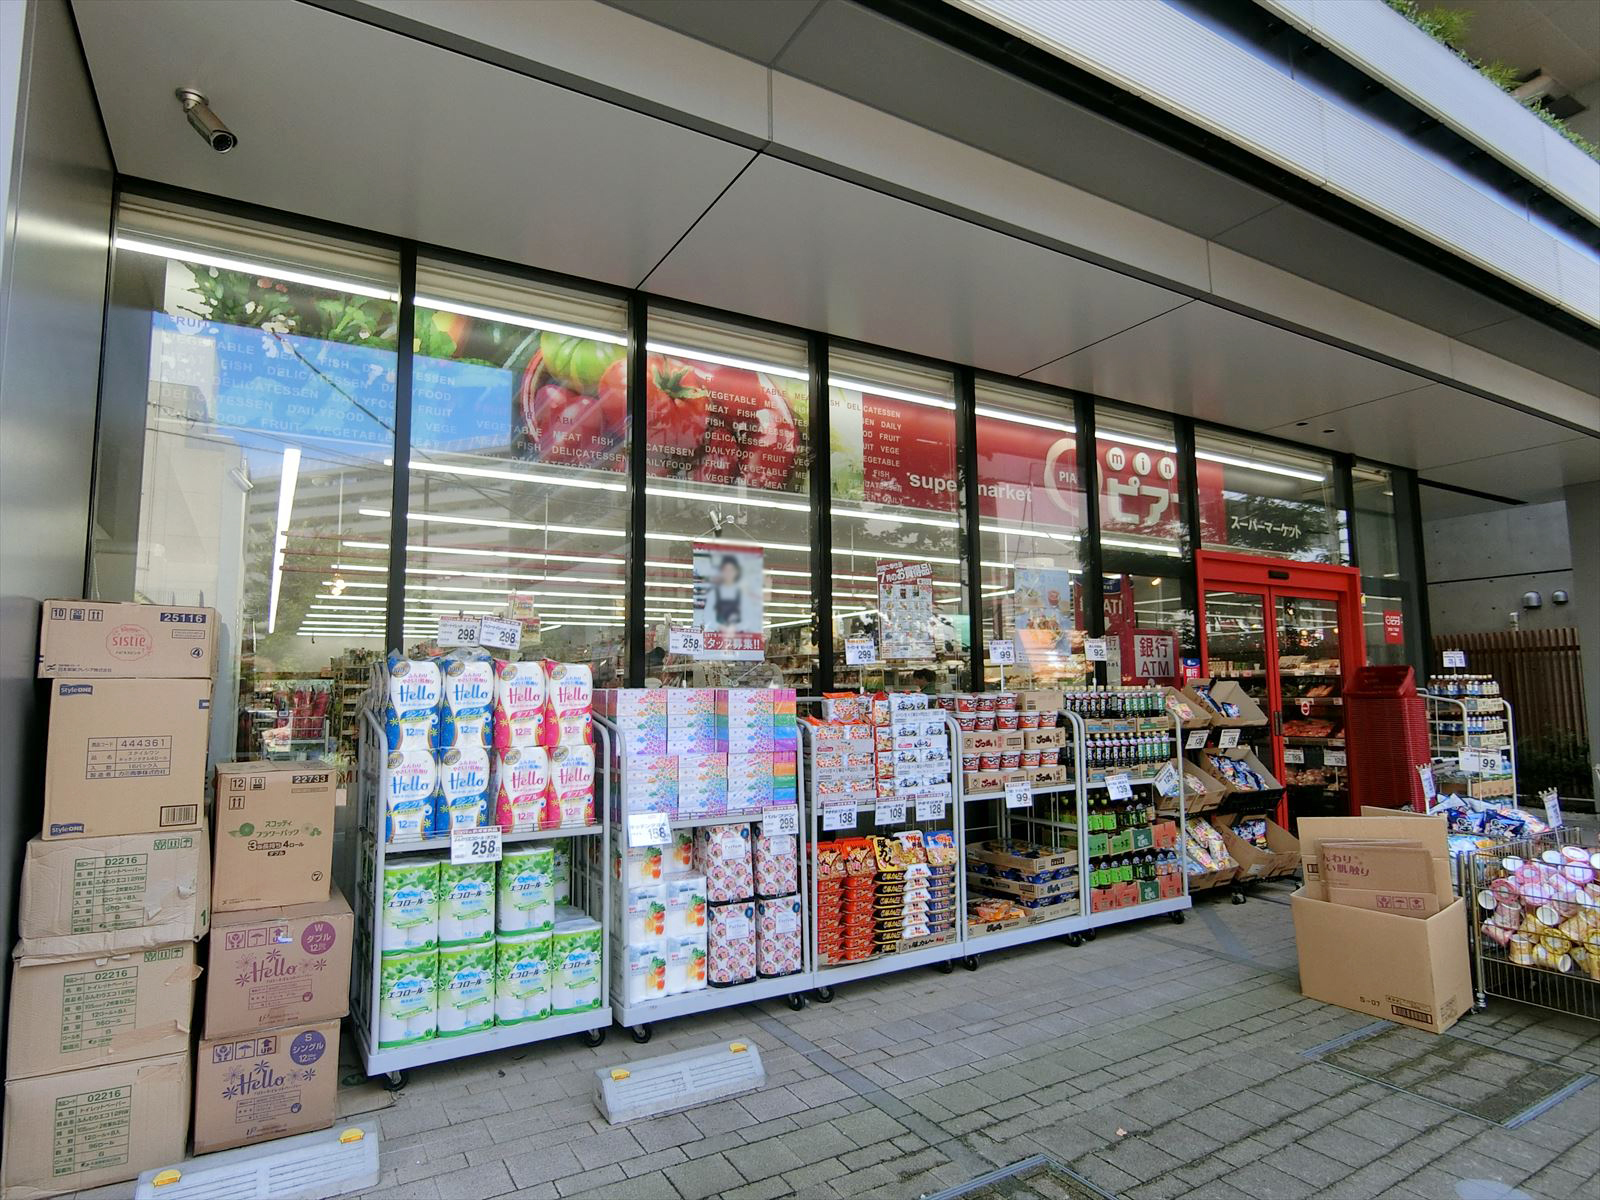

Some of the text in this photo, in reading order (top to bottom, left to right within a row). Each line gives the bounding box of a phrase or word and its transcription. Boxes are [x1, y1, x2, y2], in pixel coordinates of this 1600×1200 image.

[705, 390, 902, 431] VEGETABLE DAILY
[704, 403, 901, 443] MEAT FISH FRUIT
[553, 430, 582, 442] MEAT
[591, 435, 614, 447] FISH
[705, 417, 725, 428] FISH
[880, 445, 900, 456] VEGE
[552, 442, 628, 463] DELICATESSEN
[646, 458, 692, 471] AILYFOOD
[705, 445, 756, 459] DAILYFOOD
[762, 453, 786, 464] FRUIT
[863, 455, 901, 467] EGETABLE
[705, 459, 788, 478] FRUIT VEGETABLE
[705, 473, 757, 487] VEGETABLE
[765, 479, 788, 490] MEAT
[1230, 515, 1302, 539] スーパーマーケット
[53, 609, 64, 617] 10
[163, 614, 203, 623] 25116
[457, 628, 475, 641] 298
[499, 631, 516, 644] 298
[682, 638, 699, 649] 258
[1139, 637, 1168, 658] 銀行
[858, 650, 872, 659] 299
[999, 650, 1011, 659] 99
[1093, 648, 1104, 657] 92
[1141, 661, 1170, 676] ATM
[398, 684, 435, 703] Hello
[453, 684, 488, 701] Hello
[507, 687, 540, 705] Hello
[557, 686, 588, 703] Hello
[405, 728, 415, 737] 12
[460, 726, 470, 734] 12
[515, 728, 524, 736] 12
[564, 726, 573, 734] 12
[121, 739, 165, 747] 444361
[1481, 757, 1497, 769] 99
[295, 775, 326, 784] 22733
[448, 772, 484, 790] Hello
[511, 771, 545, 789] Hello
[558, 768, 592, 785] Hello
[233, 779, 244, 788] 12
[390, 776, 430, 794] Hello
[1016, 792, 1028, 803] 99
[564, 809, 574, 817] 12
[889, 807, 903, 818] 109
[929, 804, 942, 814] 128
[455, 815, 465, 823] 12
[518, 812, 527, 821] 12
[839, 812, 853, 824] 138
[265, 820, 293, 828] スコッティ
[398, 820, 409, 829] 12
[779, 817, 794, 829] 298
[256, 829, 300, 838] フラワーパック
[648, 827, 666, 840] 158
[471, 840, 496, 856] 258
[105, 857, 138, 866] 02216
[509, 881, 541, 892] エコロール
[448, 890, 482, 900] エコロール
[388, 897, 424, 908] エコロール
[200, 910, 207, 927] 1
[314, 924, 324, 932] W
[306, 935, 331, 943] ダブル
[250, 957, 299, 983] Hello
[561, 960, 591, 970] エコロール
[95, 970, 128, 980] 02216
[508, 969, 539, 980] エコロール
[448, 979, 482, 990] エコロール
[387, 987, 424, 999] エコロール
[305, 1033, 313, 1042] S
[292, 1042, 324, 1053] シングル
[299, 1055, 307, 1063] 12
[236, 1069, 286, 1095] Hello
[87, 1089, 121, 1102] 02216
